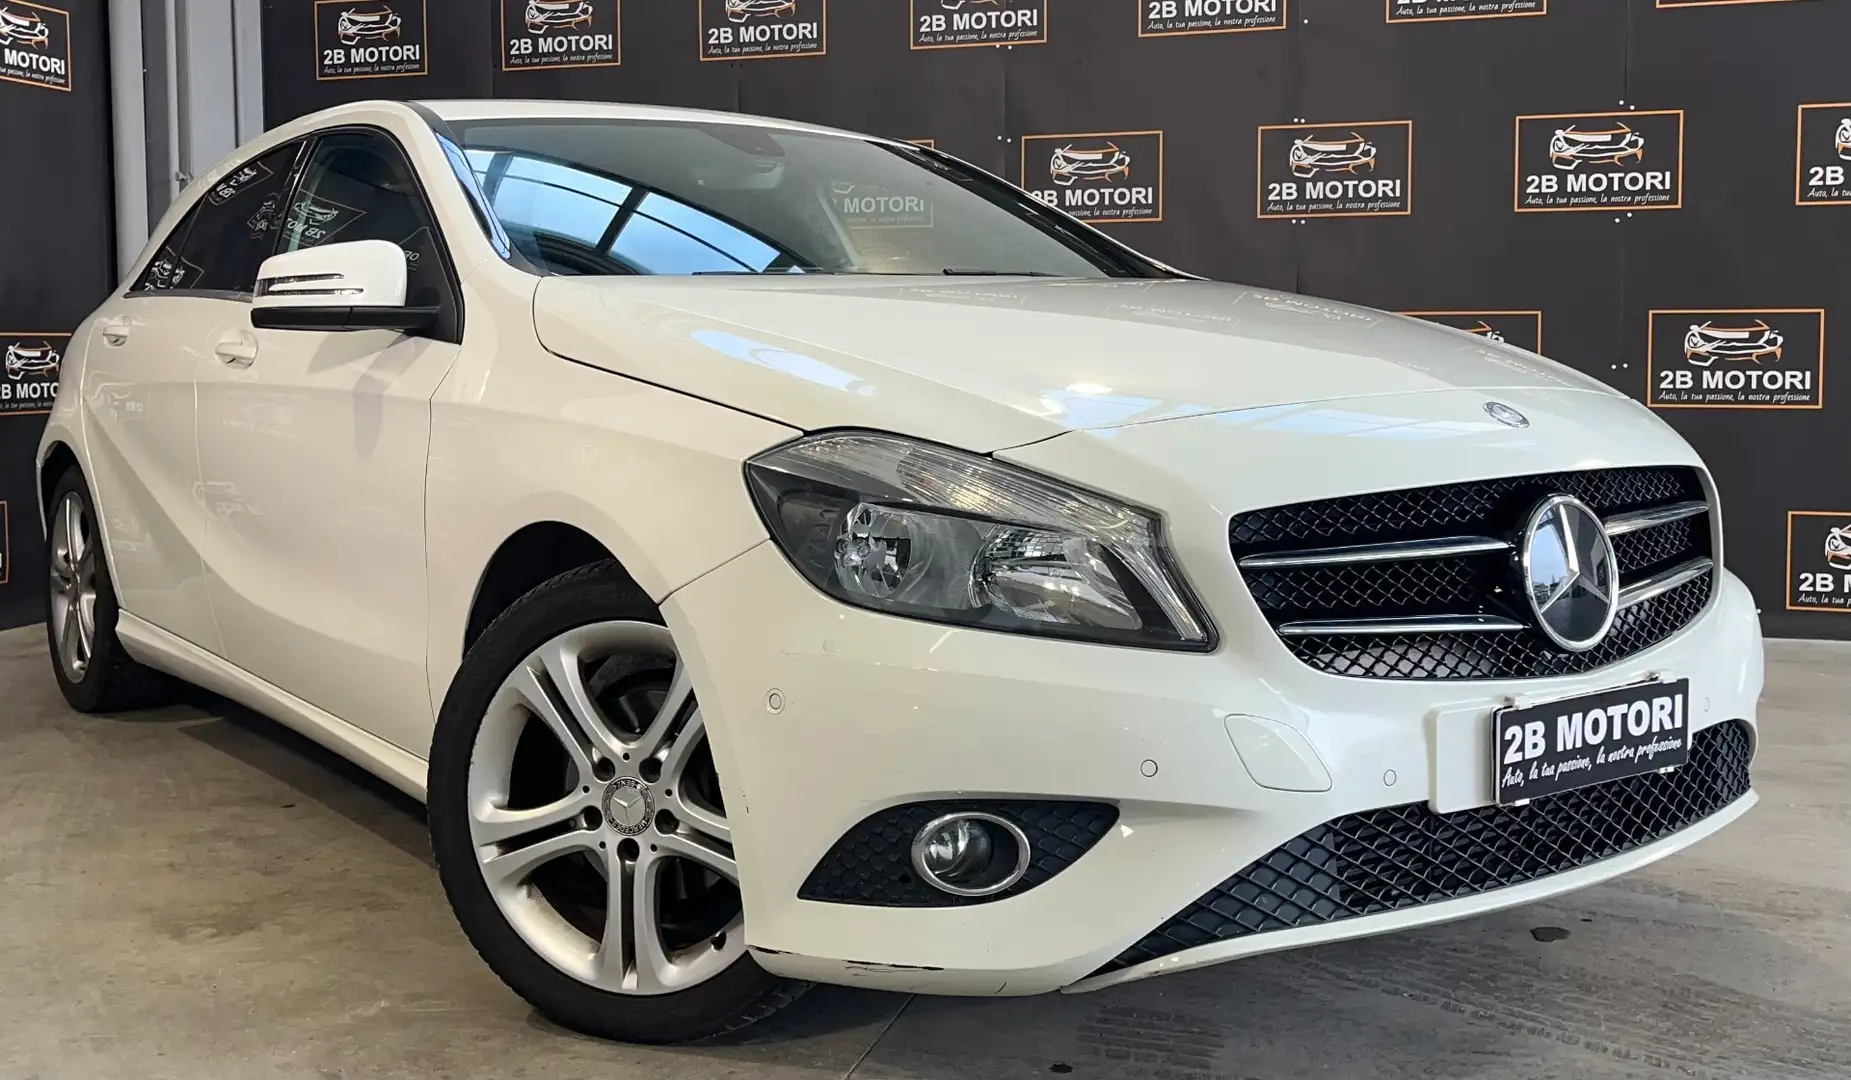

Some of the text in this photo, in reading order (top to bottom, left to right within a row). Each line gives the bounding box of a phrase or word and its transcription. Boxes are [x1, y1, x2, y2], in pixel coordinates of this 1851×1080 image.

[1148, 0, 1277, 19] 2B MOTORI
[1416, 6, 1423, 14] la
[1426, 6, 1437, 14] tua
[1468, 2, 1476, 11] la
[1500, 0, 1536, 13] professione
[920, 9, 1038, 32] 2B MOTORI
[1166, 20, 1173, 28] la
[1214, 17, 1222, 26] la
[1244, 15, 1277, 27] professione
[708, 22, 818, 44] 2B MOTORI
[510, 34, 613, 55] 2B MOTORI
[4, 48, 65, 75] MOTORI
[323, 44, 420, 65] 2B MOTORI
[1525, 171, 1671, 193] 2B MOTORI
[1808, 166, 1845, 186] 2B
[1065, 187, 1153, 206] MOTORI
[1268, 179, 1401, 200] 2B MOTORI
[1545, 195, 1553, 204] la
[1556, 196, 1567, 204] tua
[1600, 193, 1608, 203] la
[1610, 195, 1631, 203] nostra
[1633, 192, 1670, 205] professione
[1831, 187, 1839, 196] la
[1286, 202, 1293, 210] la
[1336, 200, 1343, 209] la
[1367, 199, 1401, 212] professione
[1659, 371, 1811, 390] 2B MOTORI
[0, 382, 59, 399] B MOTO
[1681, 391, 1688, 400] la
[1691, 392, 1703, 400] tua
[1738, 391, 1745, 401] la
[1749, 393, 1770, 401] nostra
[1773, 391, 1811, 404] professione
[1799, 572, 1835, 592] 2B
[1820, 594, 1829, 603] la
[1503, 694, 1683, 764] 2B MOTORI
[1529, 761, 1538, 780] la
[1541, 762, 1555, 777] tua
[1596, 746, 1605, 764] la
[1608, 746, 1635, 762] nostra
[1635, 736, 1682, 763] professione
